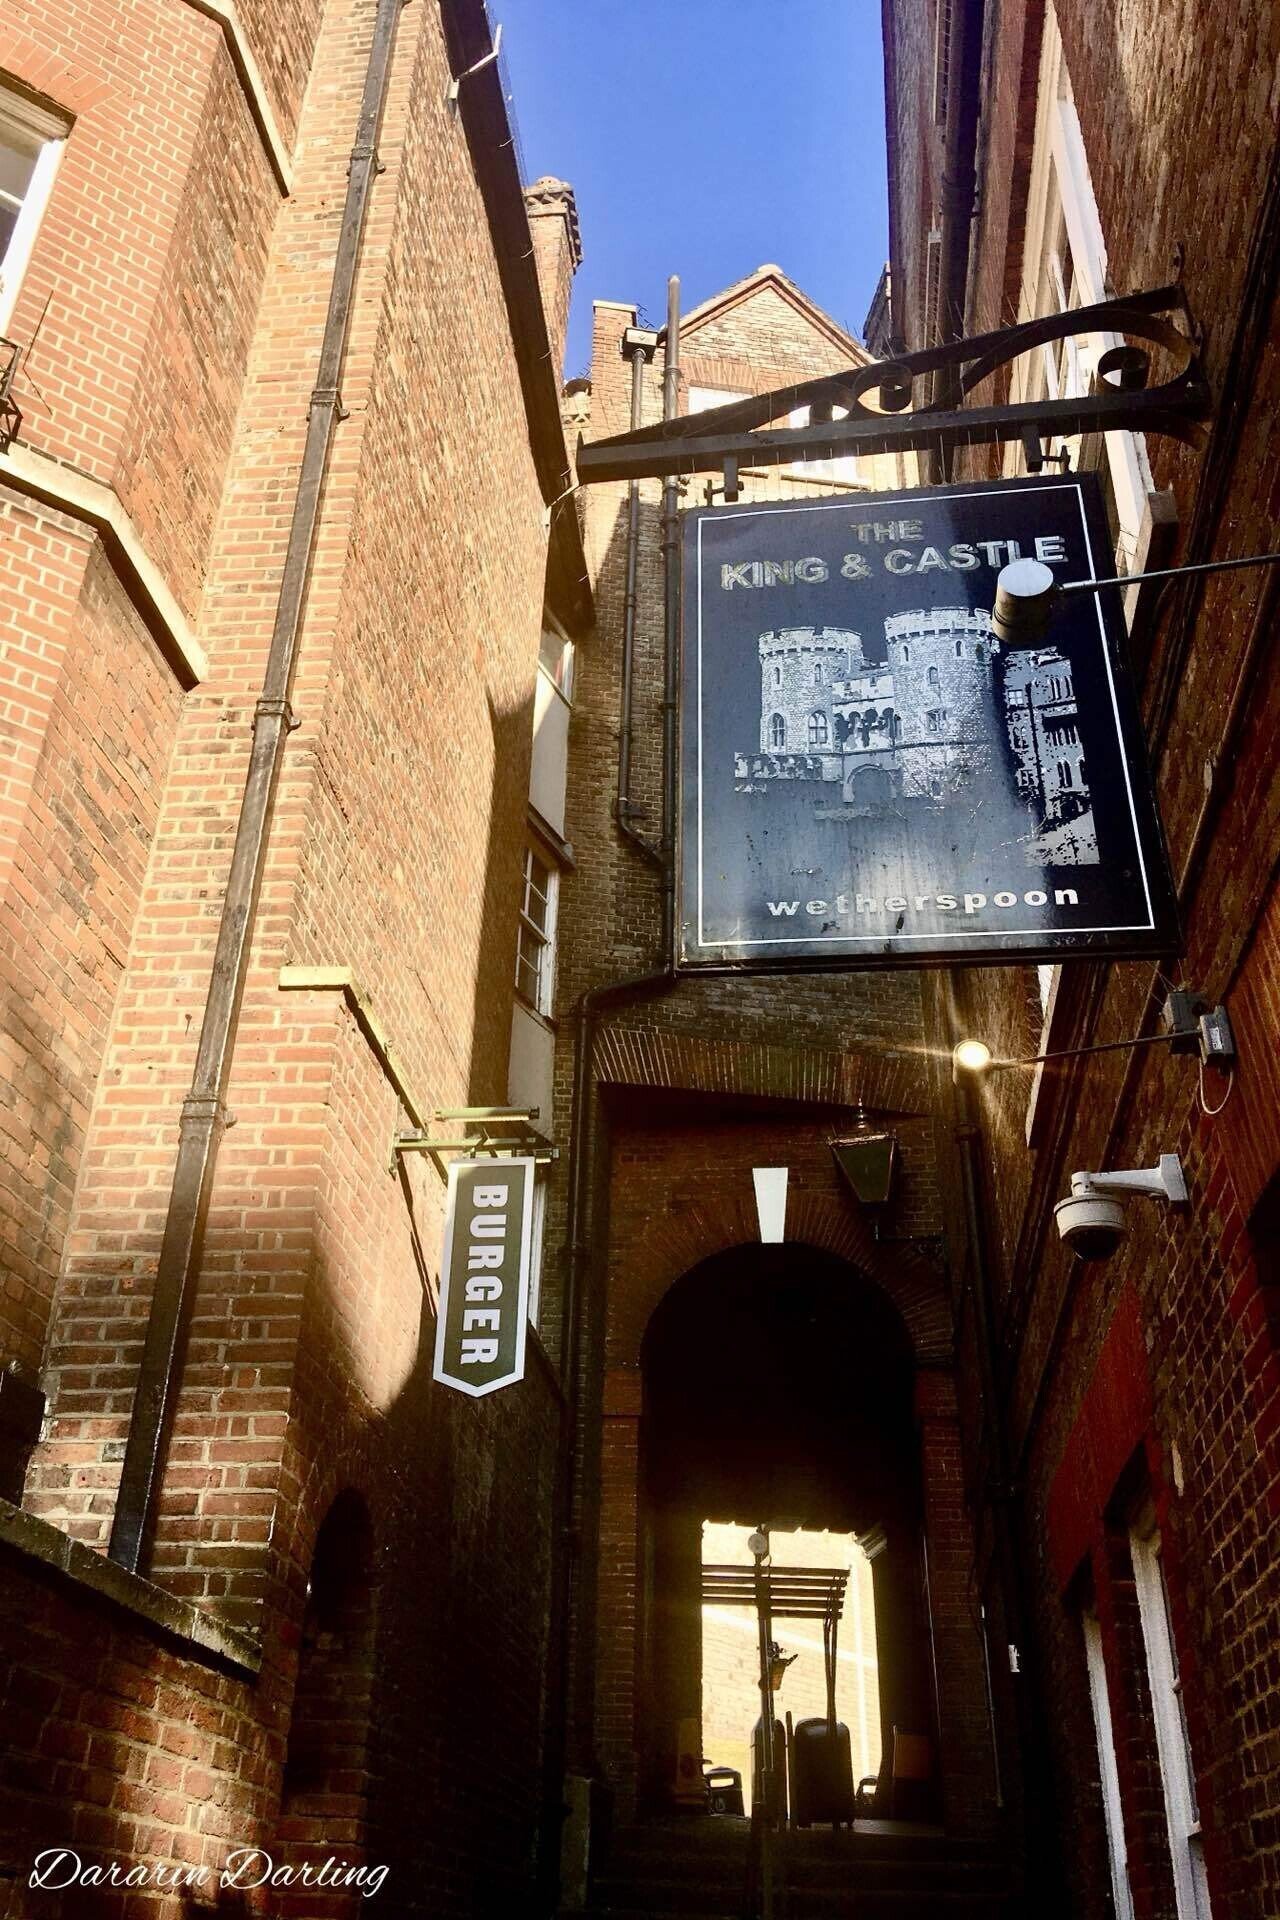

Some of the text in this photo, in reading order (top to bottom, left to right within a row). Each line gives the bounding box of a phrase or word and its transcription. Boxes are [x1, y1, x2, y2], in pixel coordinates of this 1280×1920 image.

[850, 519, 925, 544] THE
[720, 535, 1068, 591] KING & CASTLE
[766, 887, 1080, 916] wetherspoon
[460, 1185, 509, 1365] BURGER
